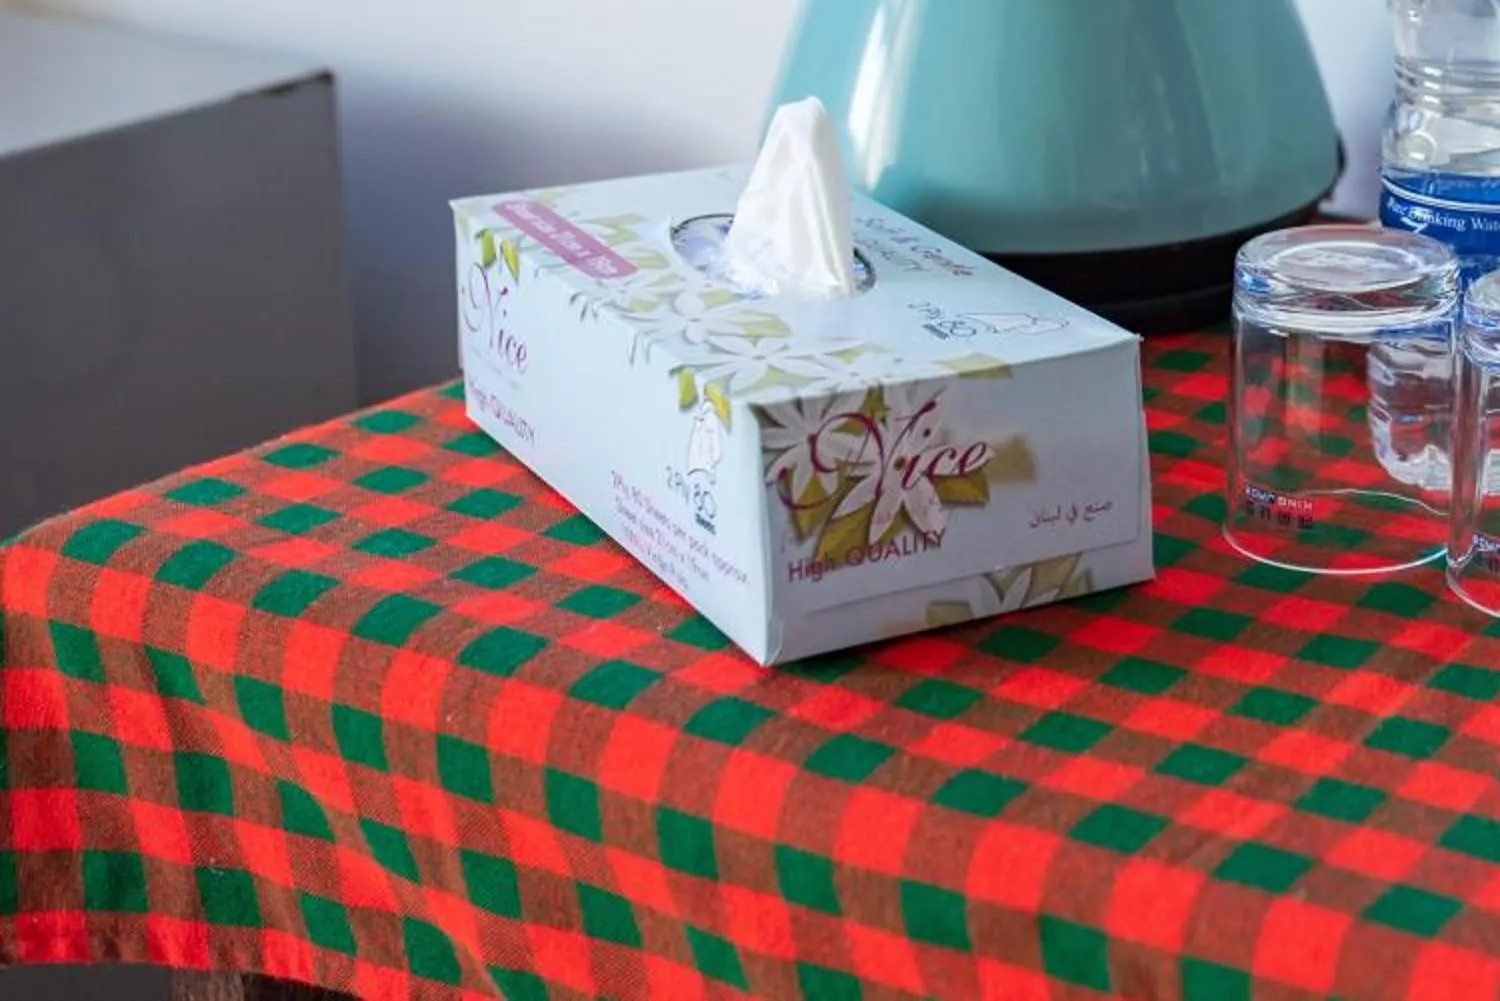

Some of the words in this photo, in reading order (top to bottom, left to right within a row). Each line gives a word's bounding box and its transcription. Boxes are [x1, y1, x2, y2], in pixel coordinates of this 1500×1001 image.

[1408, 206, 1466, 232] Drinking
[1083, 500, 1114, 523] صنع
[787, 551, 837, 584] High
[844, 527, 946, 566] QUALITY
